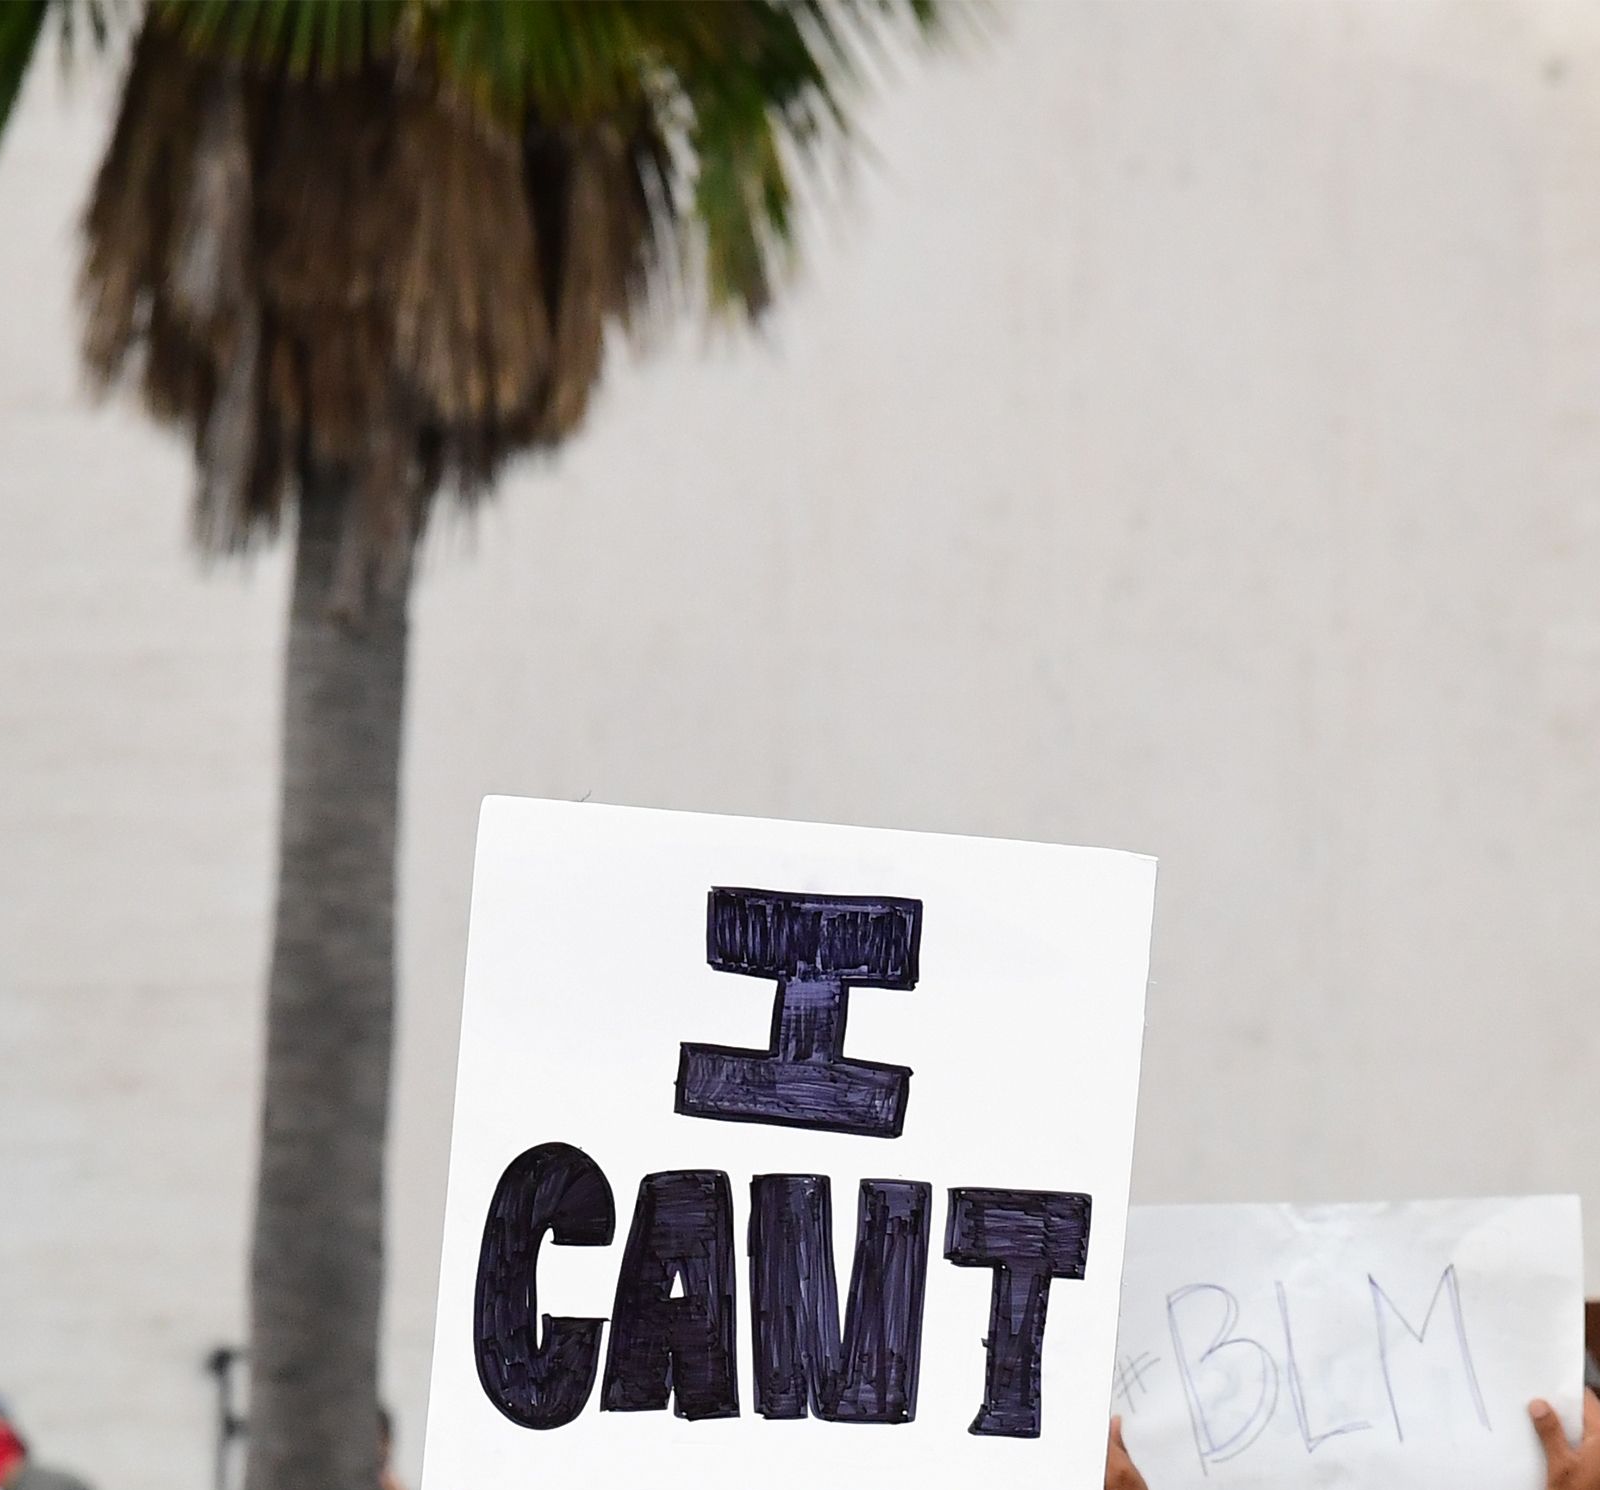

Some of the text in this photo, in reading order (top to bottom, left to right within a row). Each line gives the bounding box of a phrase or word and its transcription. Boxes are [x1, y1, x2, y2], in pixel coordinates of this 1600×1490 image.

[673, 886, 924, 1138] I
[474, 1141, 1092, 1438] CANT
[1114, 1264, 1492, 1477] #BLM
